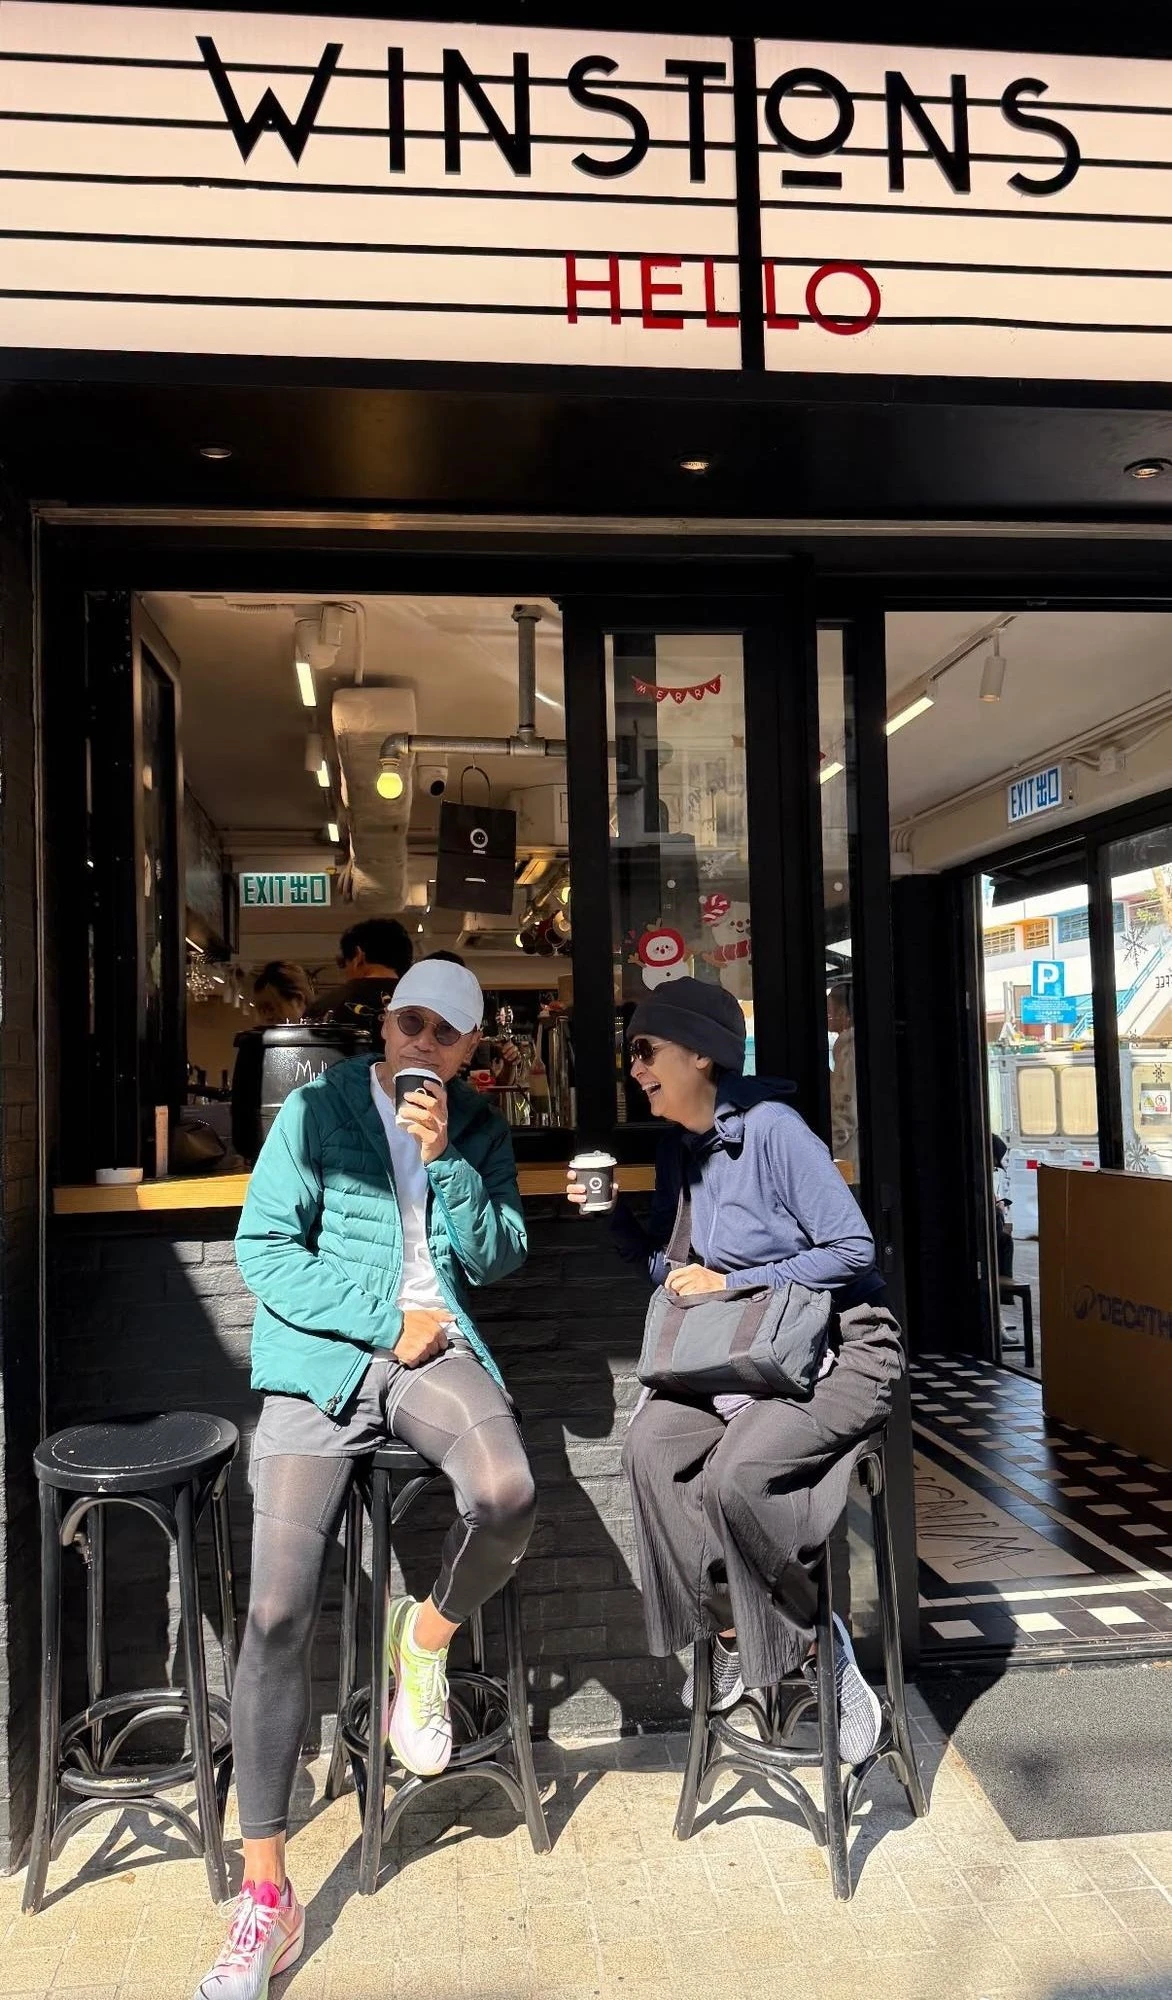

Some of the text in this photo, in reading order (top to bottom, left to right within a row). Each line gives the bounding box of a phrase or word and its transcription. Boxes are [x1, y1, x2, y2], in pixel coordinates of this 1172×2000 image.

[196, 35, 1081, 198] WINSTONS
[565, 252, 882, 336] HELLO
[637, 682, 717, 701] MERRY
[1011, 767, 1059, 818] EXIT 出口
[244, 875, 327, 904] EXIT 出口
[1037, 962, 1060, 995] P
